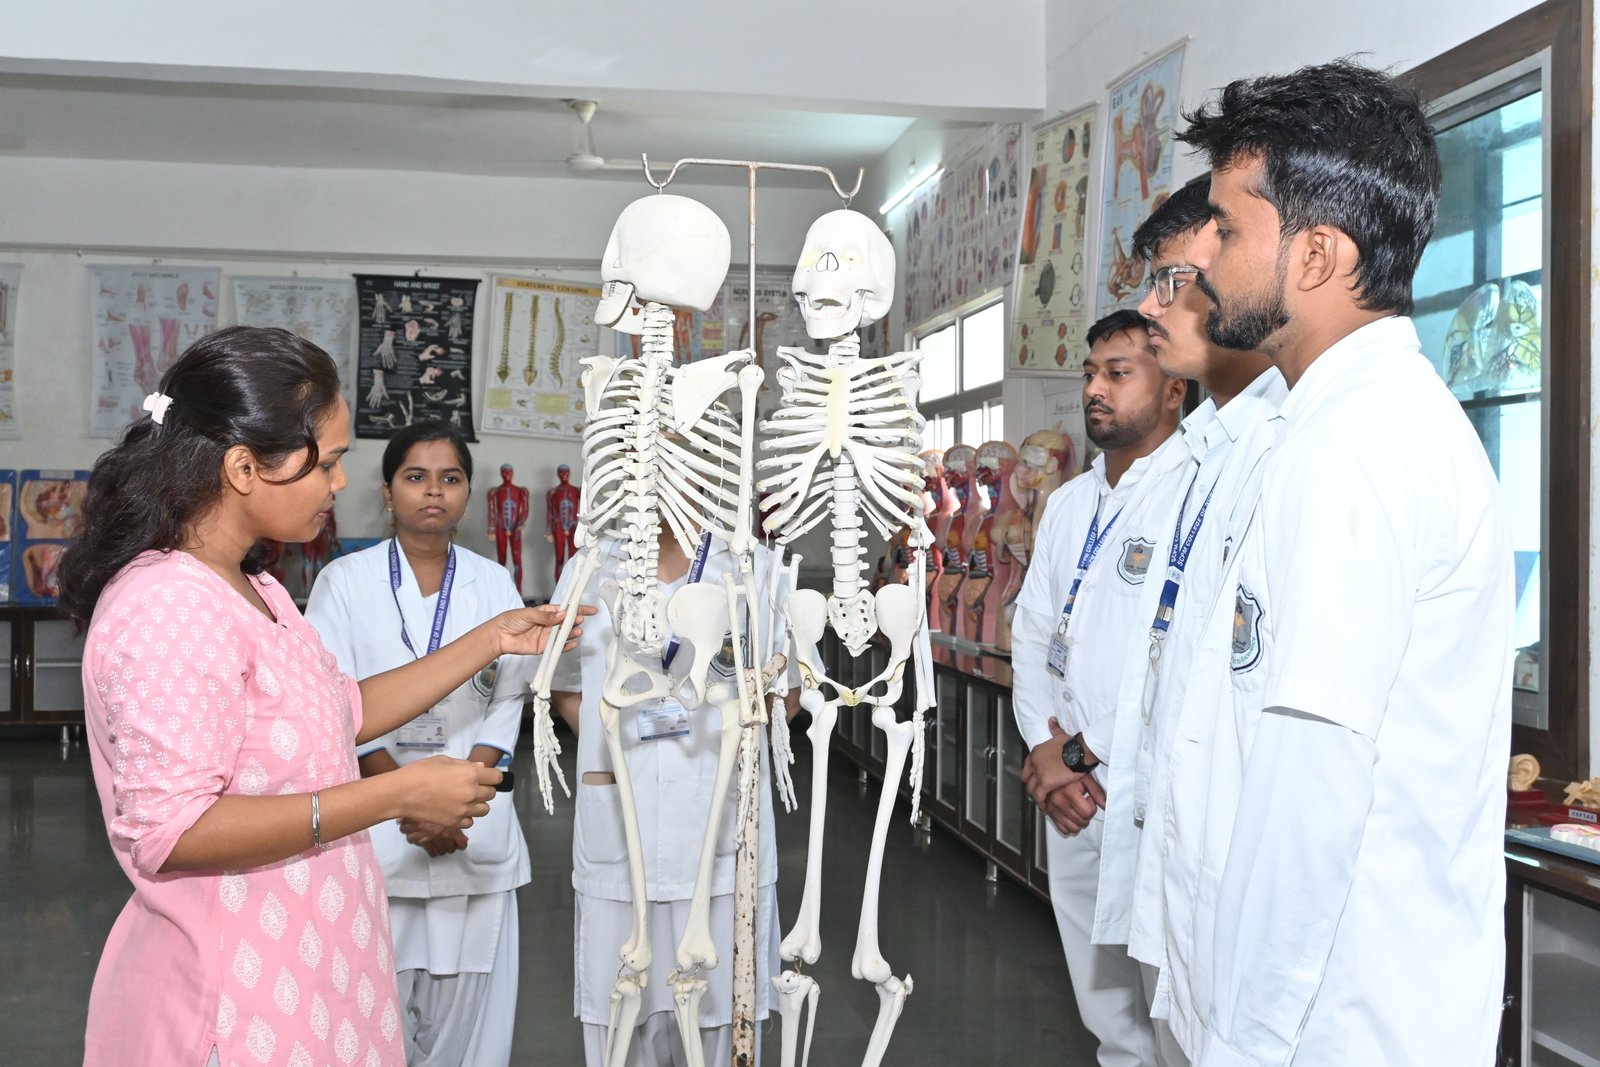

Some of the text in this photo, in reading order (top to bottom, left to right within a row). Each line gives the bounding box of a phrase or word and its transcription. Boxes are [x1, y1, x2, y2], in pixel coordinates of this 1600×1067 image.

[393, 281, 441, 290] HAND AND WRIST
[517, 280, 588, 295] VERTEBRAL COLUMN
[1085, 531, 1097, 553] COLLEGE
[1177, 546, 1188, 566] SCPM
[1185, 518, 1202, 546] COLLEGE
[435, 610, 444, 630] NURSING
